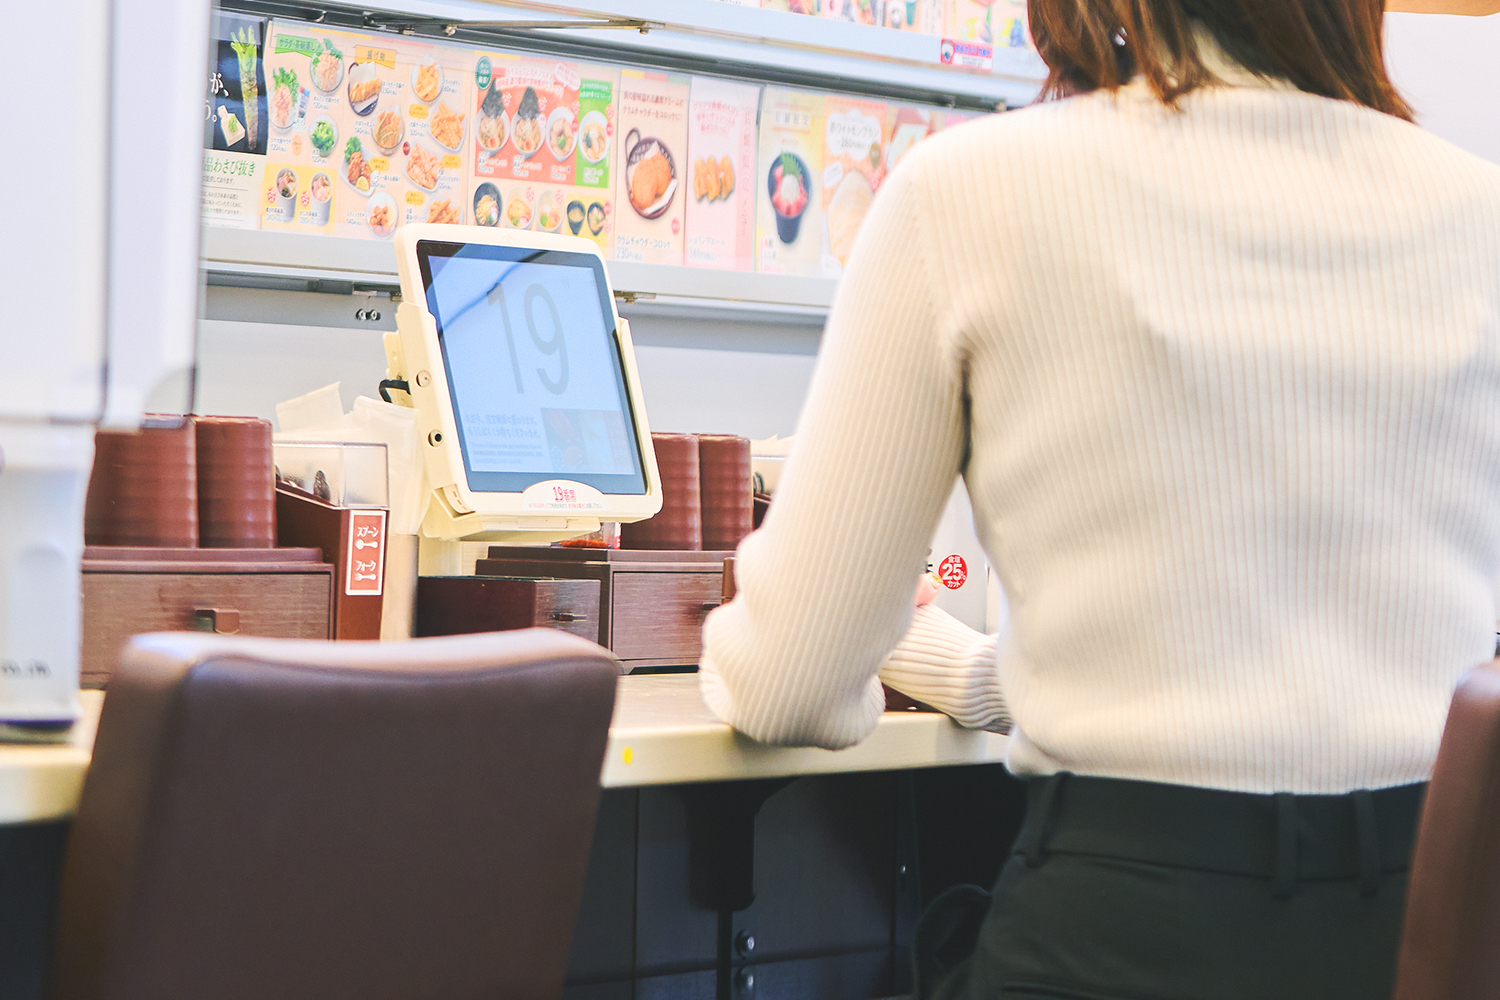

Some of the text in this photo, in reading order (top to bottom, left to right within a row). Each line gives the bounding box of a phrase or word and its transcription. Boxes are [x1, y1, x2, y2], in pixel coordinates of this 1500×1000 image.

[829, 121, 880, 138] ホワイトモンブラン
[203, 156, 256, 177] 品わさび抜き
[616, 234, 671, 250] クラムチャウダーコロッケ
[487, 282, 570, 396] 19
[357, 525, 379, 538] スプーン
[355, 560, 377, 572] フォーク
